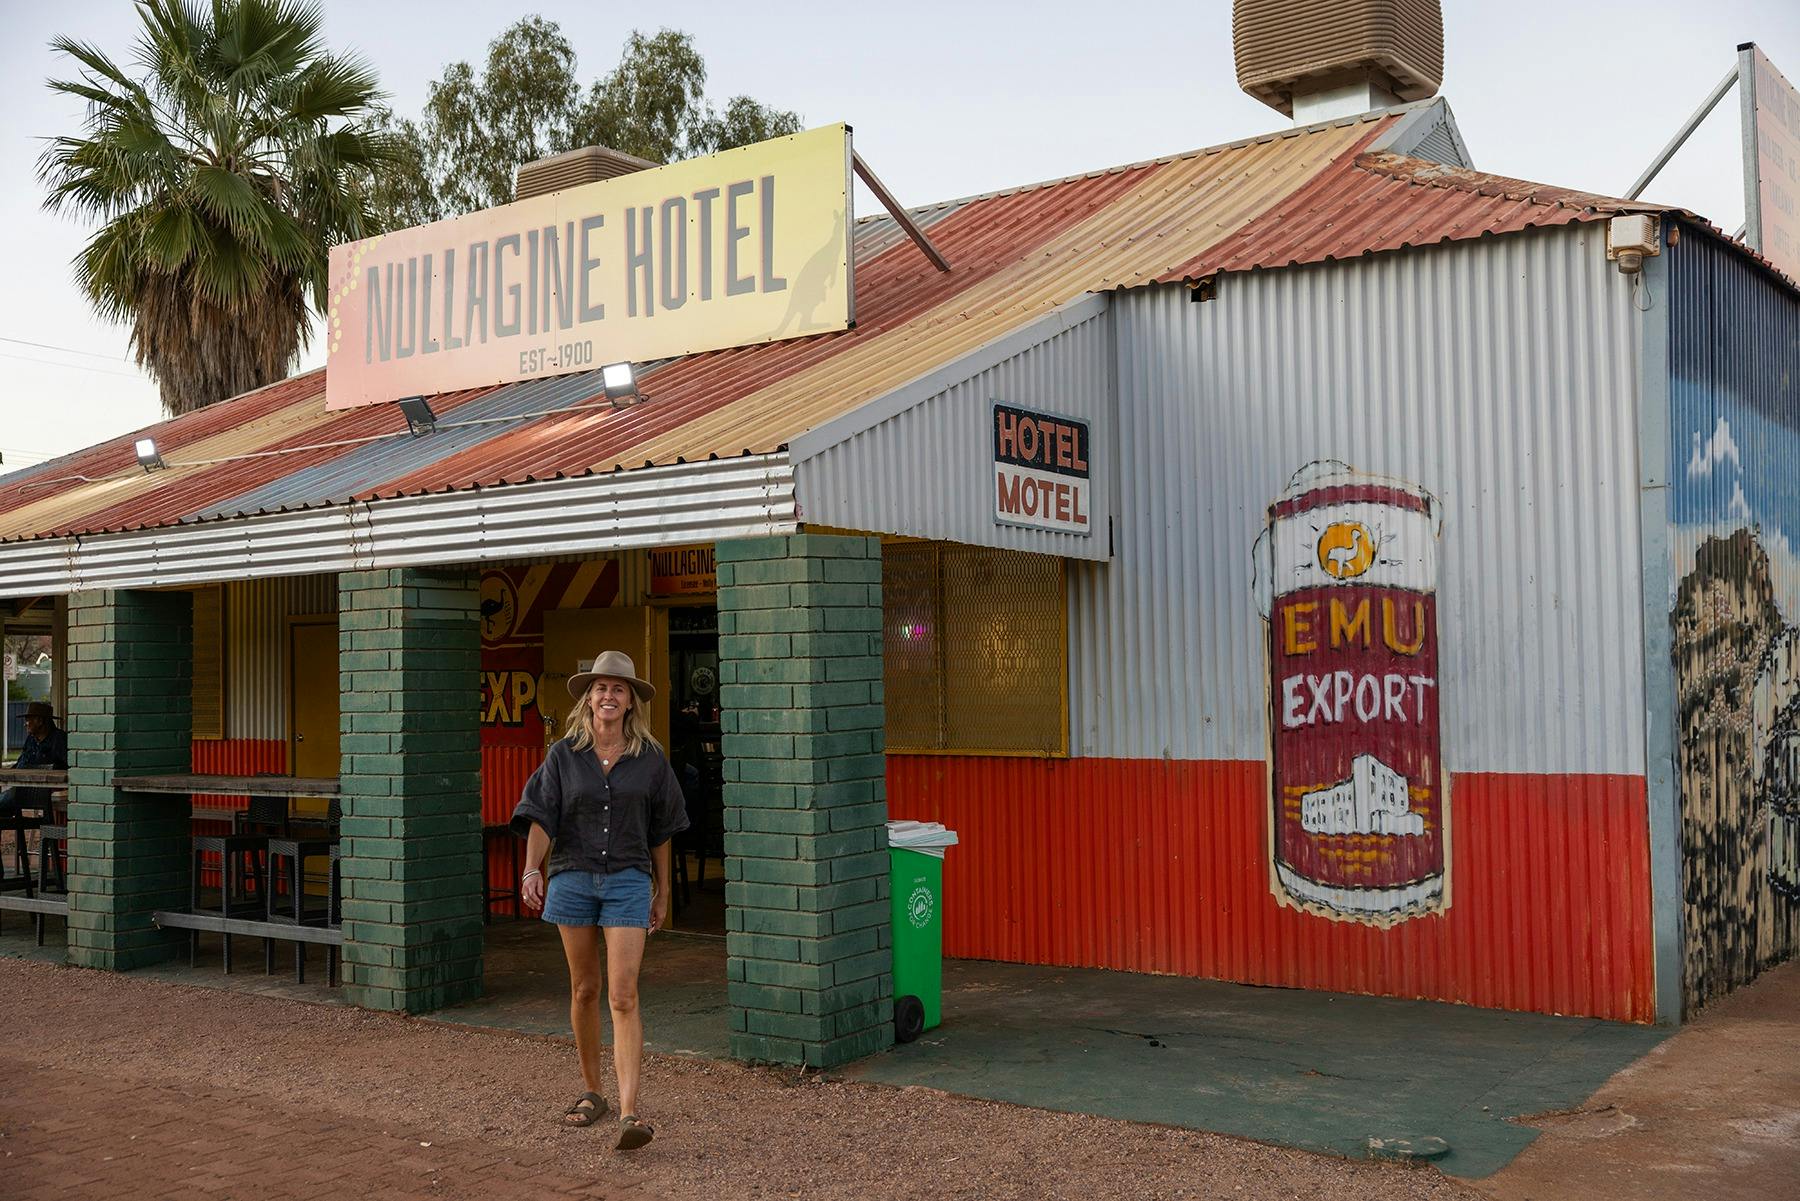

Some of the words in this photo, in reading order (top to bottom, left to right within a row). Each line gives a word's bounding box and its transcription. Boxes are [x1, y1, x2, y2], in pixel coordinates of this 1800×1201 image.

[366, 214, 605, 364] NULLAGINE
[626, 175, 787, 318] HOTEL
[998, 411, 1087, 472] HOTEL
[998, 471, 1087, 525] MOTEL
[1283, 597, 1425, 656] EMU
[1282, 670, 1435, 729] EXPORT
